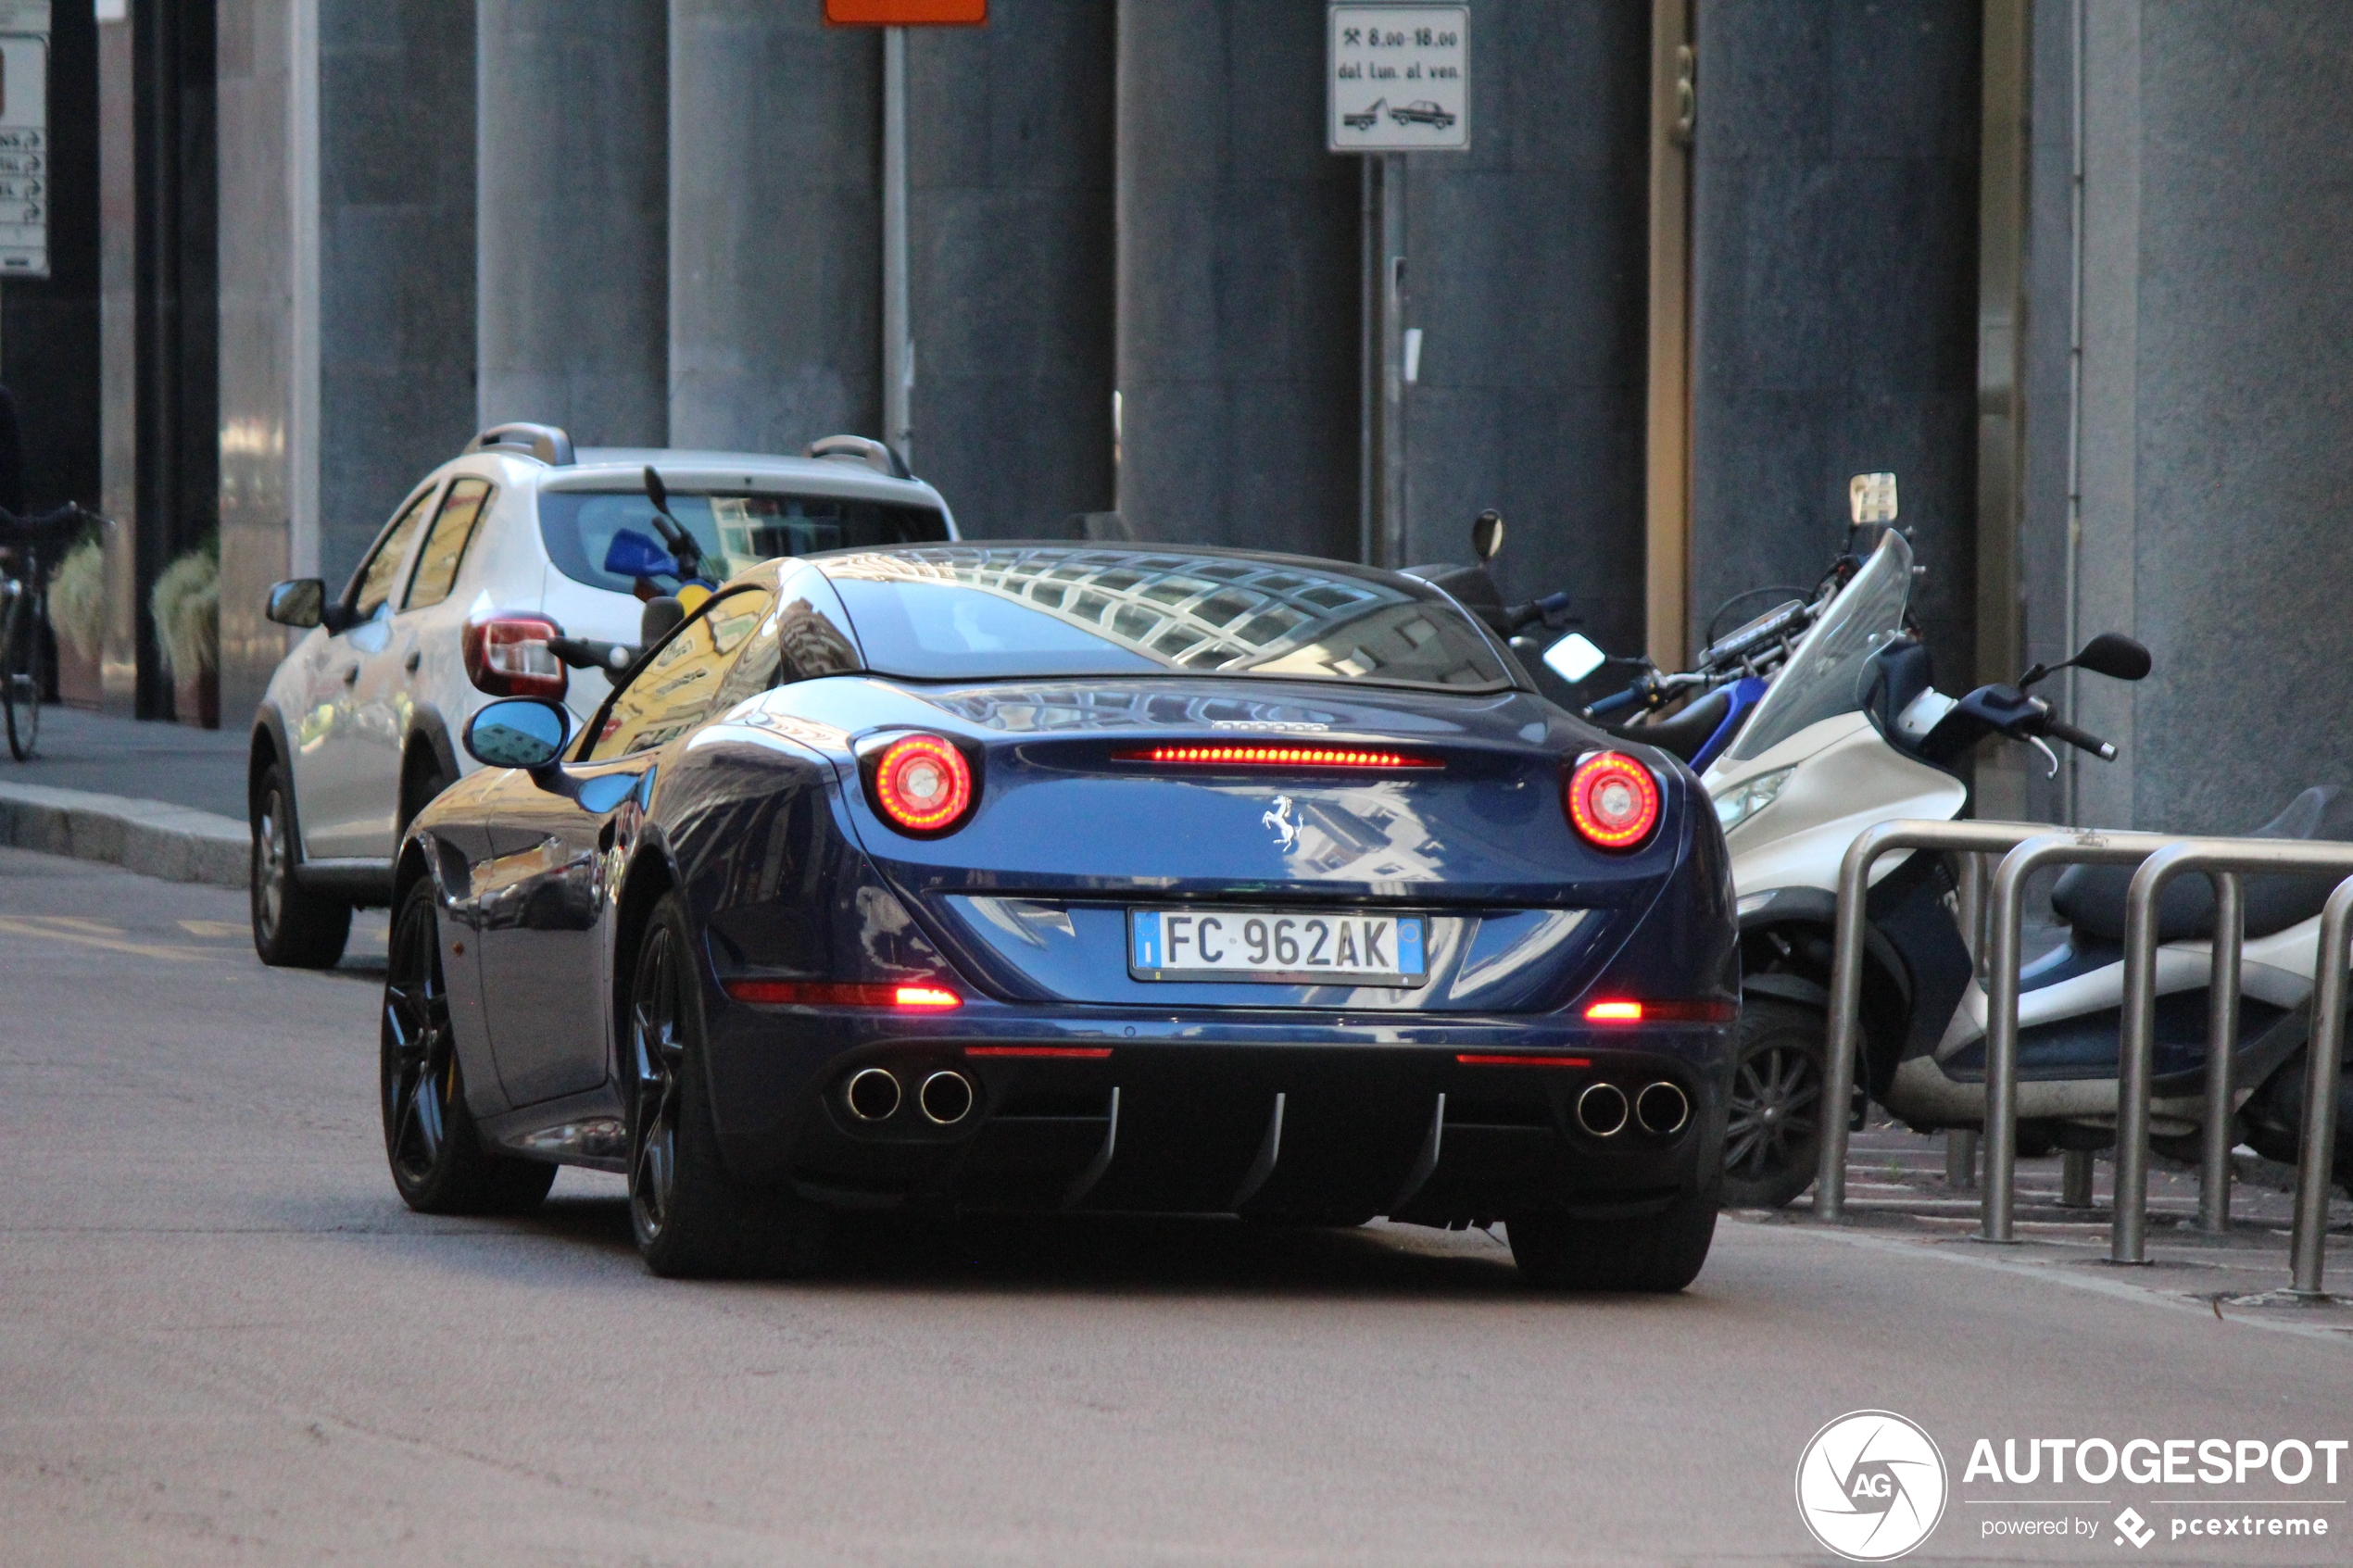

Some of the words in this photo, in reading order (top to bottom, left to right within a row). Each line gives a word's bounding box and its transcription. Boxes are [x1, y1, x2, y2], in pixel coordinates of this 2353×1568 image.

[1339, 61, 1362, 78] dal
[1406, 61, 1421, 78] al
[1167, 916, 1224, 963] FC
[1243, 919, 1390, 967] 962AK
